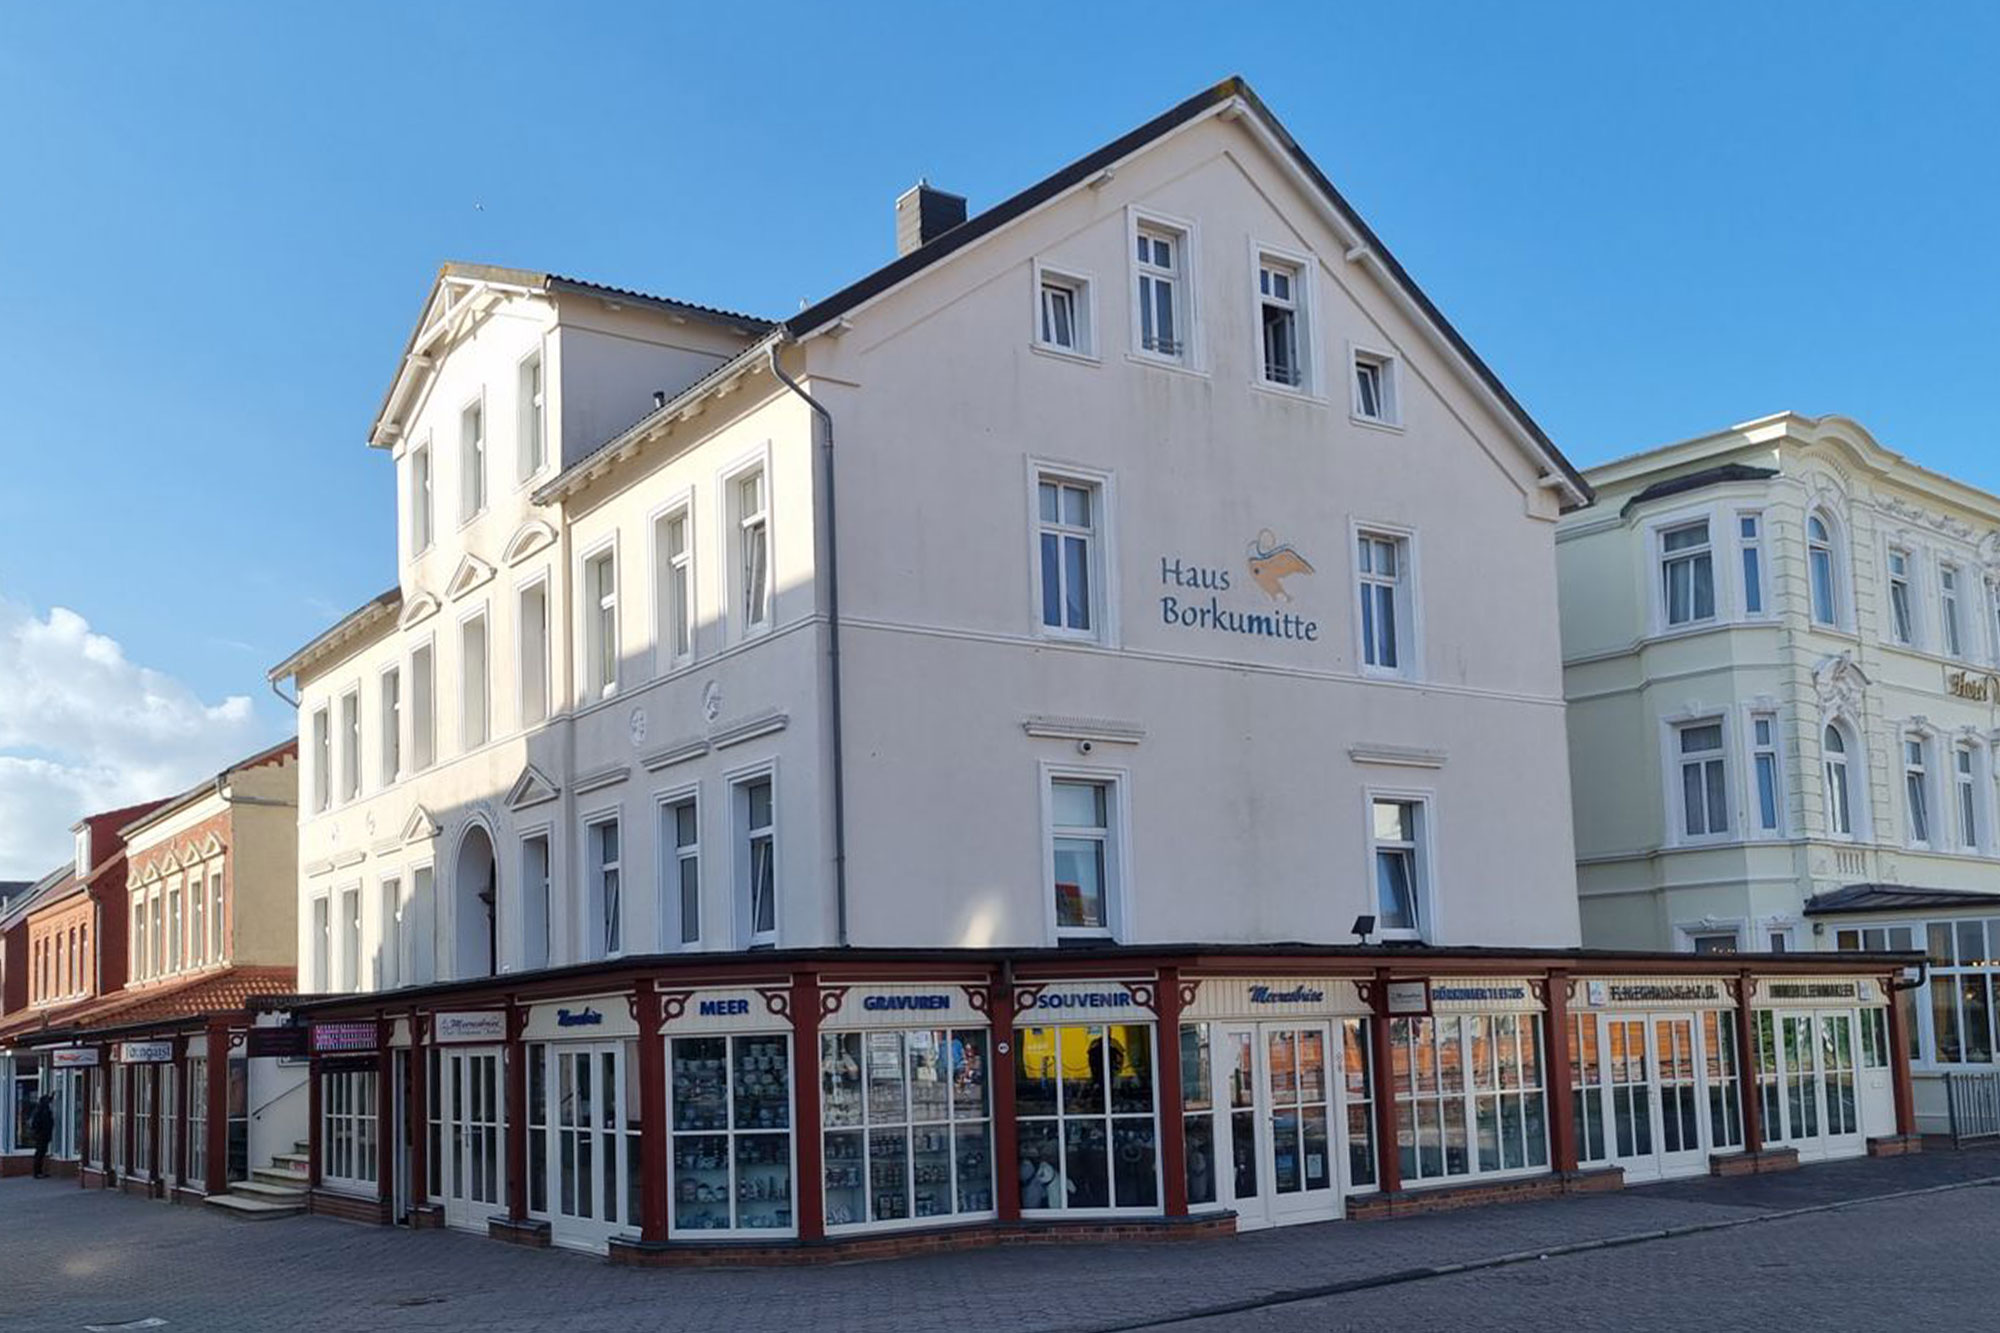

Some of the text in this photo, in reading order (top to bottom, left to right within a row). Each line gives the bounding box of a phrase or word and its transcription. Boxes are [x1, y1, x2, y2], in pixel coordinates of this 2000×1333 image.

[1161, 557, 1231, 591] Haus
[1161, 597, 1318, 641] Borkumitte
[864, 995, 950, 1010] GRAVUREN
[1038, 993, 1130, 1008] SOUVENIR
[1249, 985, 1324, 1003] Meeresbrise
[700, 999, 749, 1015] MEER
